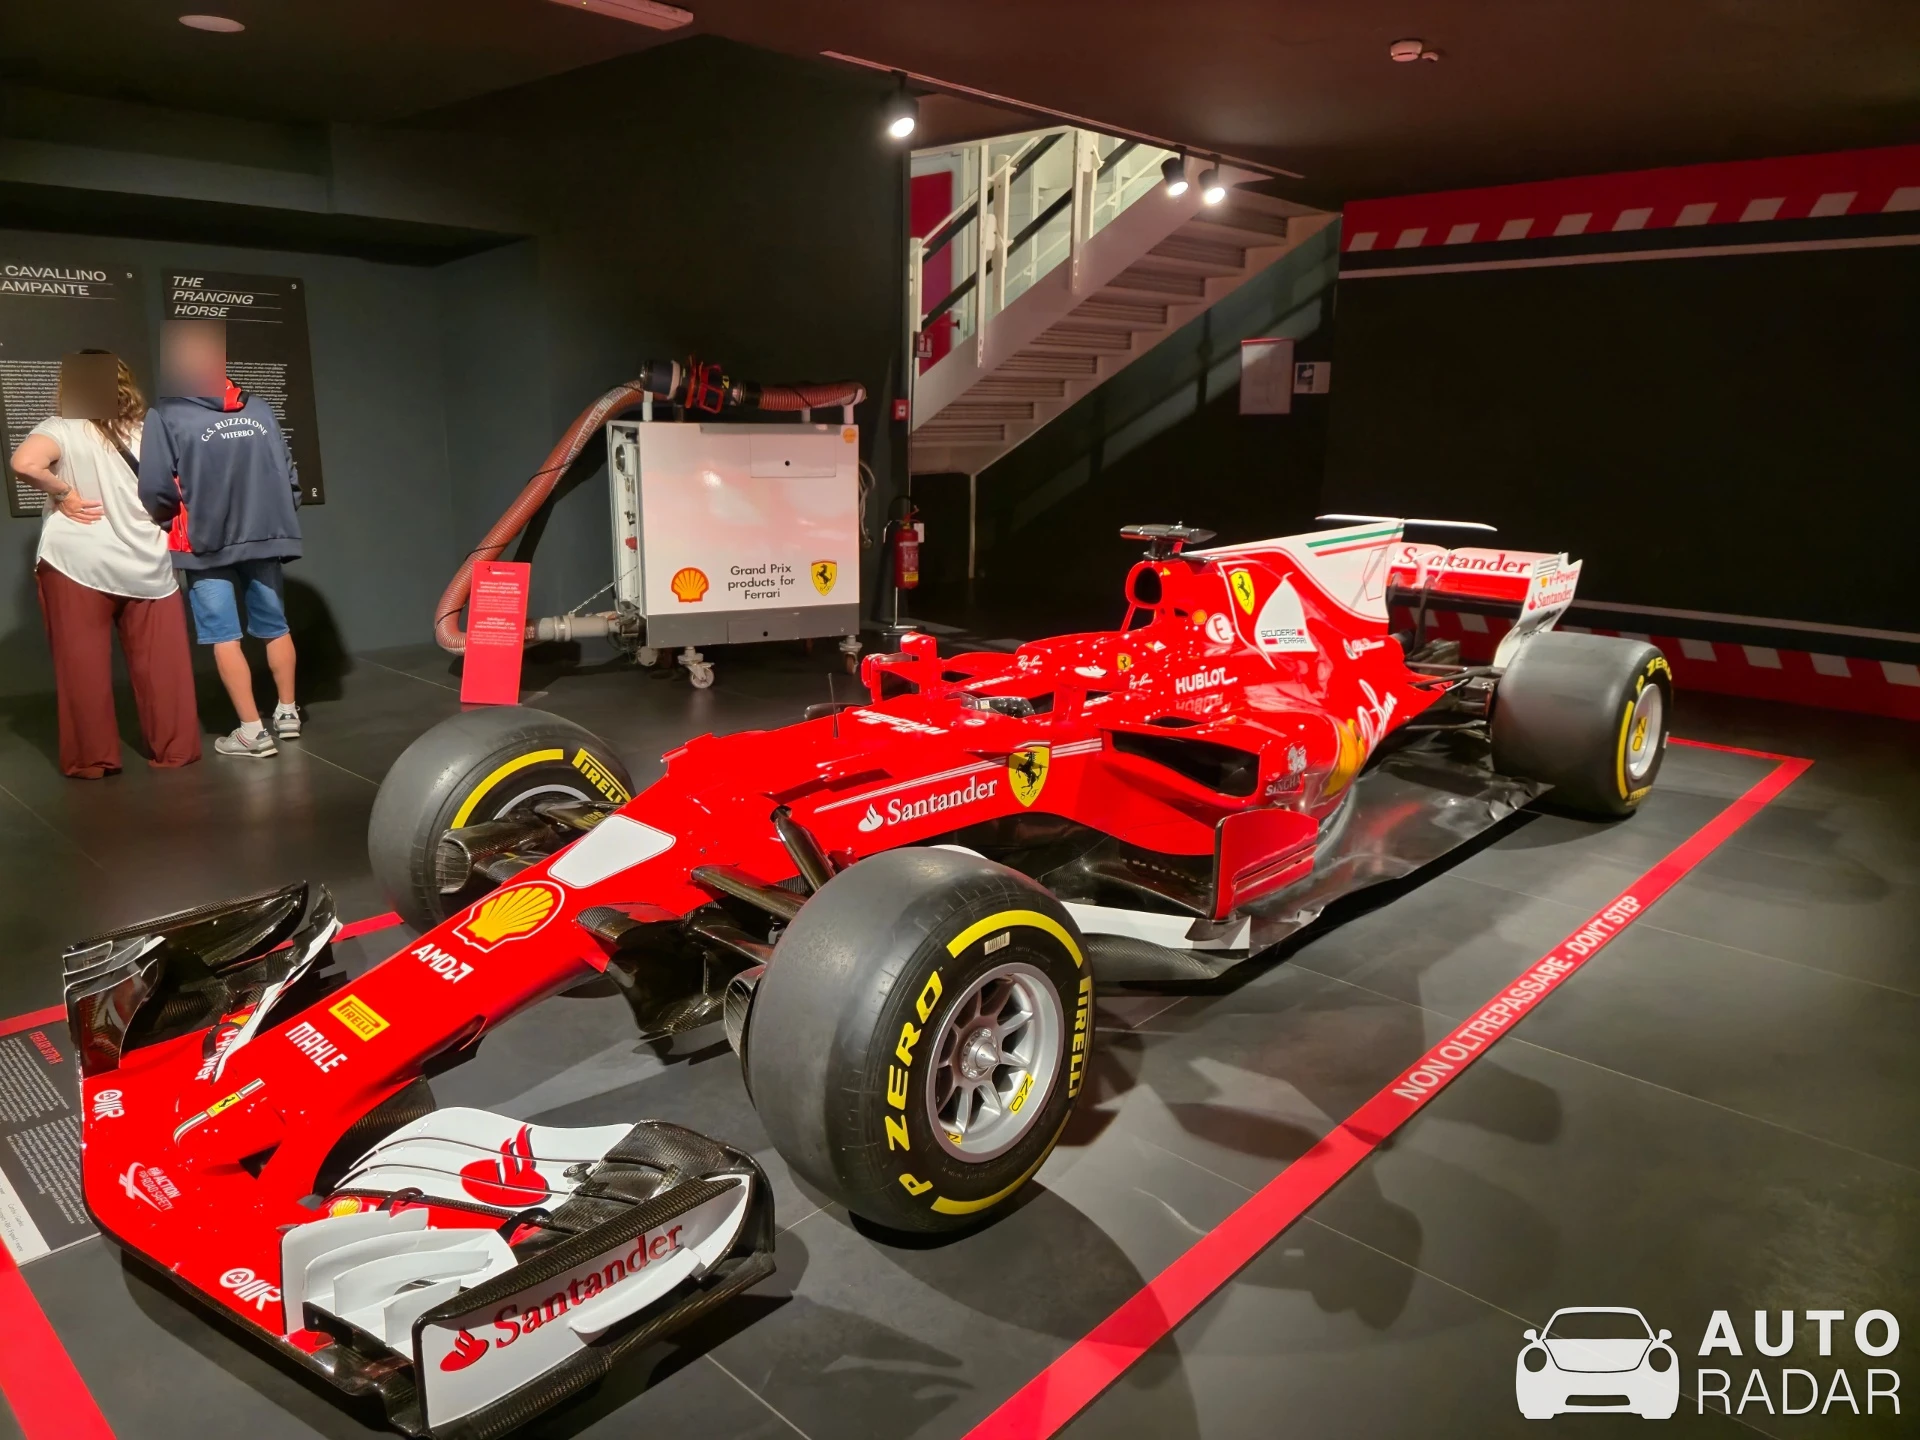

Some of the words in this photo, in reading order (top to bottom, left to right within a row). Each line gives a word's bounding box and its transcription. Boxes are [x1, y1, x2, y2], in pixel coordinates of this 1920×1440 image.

[5, 266, 107, 282] CAVALLINO
[173, 276, 204, 288] THE
[0, 280, 90, 296] AMPANTE
[173, 290, 254, 304] PRANCING
[174, 304, 230, 317] HORSE
[214, 418, 268, 436] RUZZOLONE
[220, 430, 254, 440] VITERBO
[730, 564, 766, 576] Grand
[770, 563, 792, 574] Prix
[728, 577, 776, 592] products
[780, 575, 796, 586] for
[744, 588, 780, 600] Ferrari
[1260, 628, 1296, 638] SCUDERIA
[1175, 667, 1227, 694] HUBLOT
[887, 775, 998, 826] Santander
[411, 943, 459, 978] AMD
[1392, 1058, 1454, 1102] NON
[1440, 956, 1574, 1062] OLTREPASSARE
[1565, 918, 1614, 956] DON'T
[1602, 896, 1641, 924] STEP
[337, 1000, 380, 1036] PIRELLI
[285, 1021, 348, 1074] MAHLE
[1068, 975, 1093, 1099] PIRELLI
[884, 970, 944, 1152] ZERO
[141, 1177, 159, 1193] ROAD
[151, 1190, 174, 1211] SAFETY
[153, 1175, 182, 1199] ACTION
[898, 1172, 934, 1196] P
[493, 1224, 684, 1350] Santander
